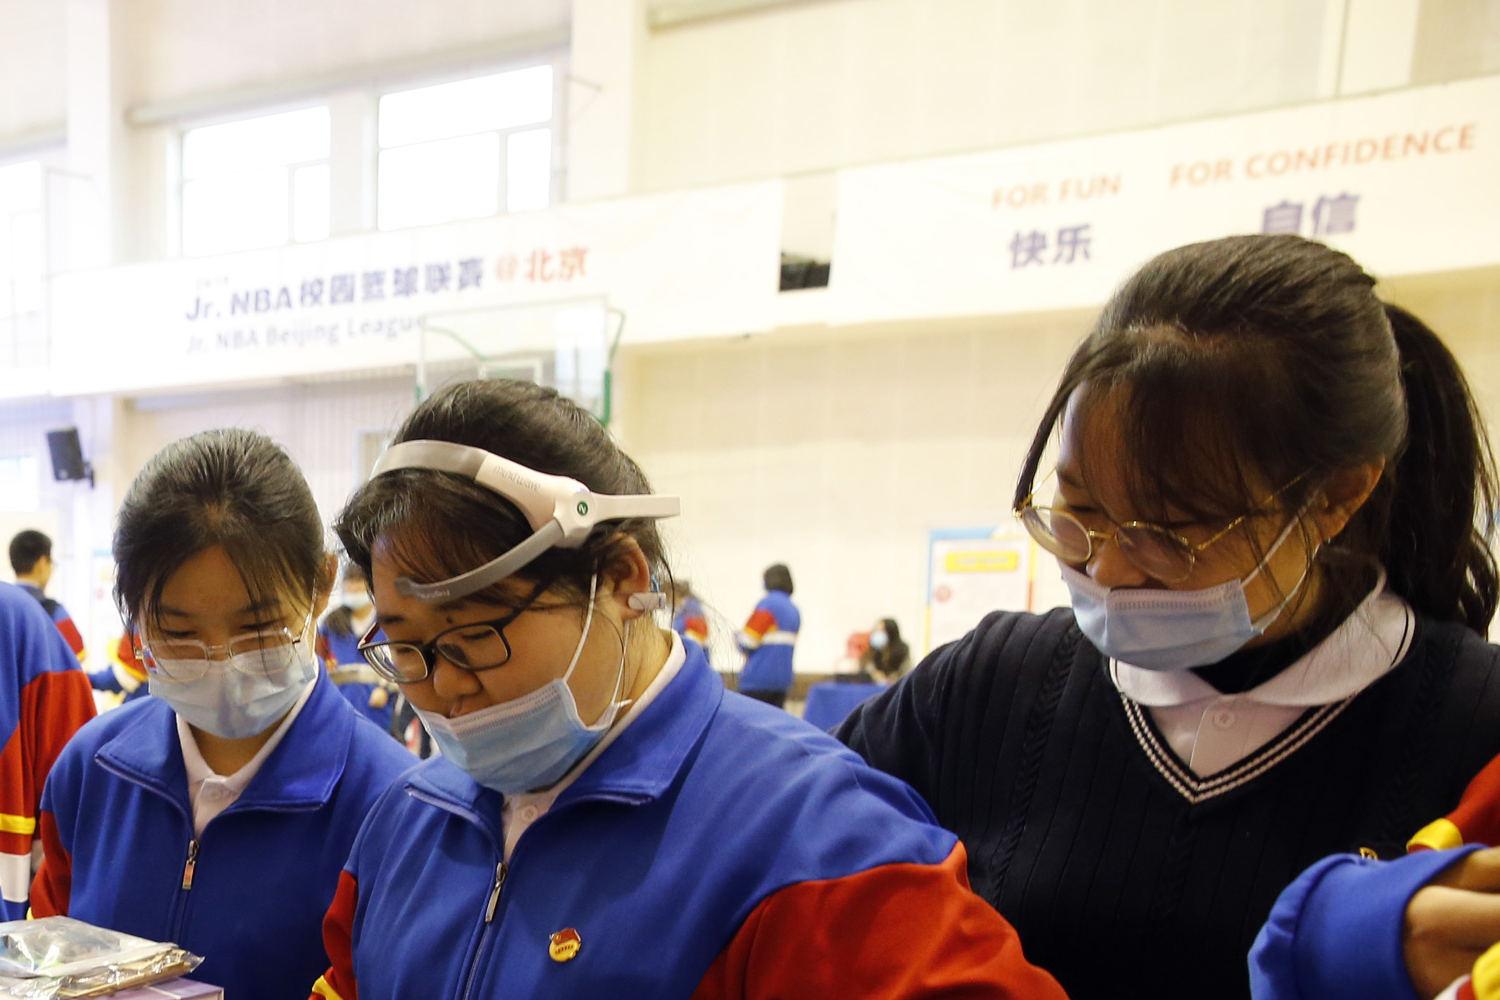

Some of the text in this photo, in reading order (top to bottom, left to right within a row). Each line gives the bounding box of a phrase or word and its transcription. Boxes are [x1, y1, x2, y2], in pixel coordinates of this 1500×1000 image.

[1170, 123, 1479, 190] FOR CONFIDENCE
[992, 174, 1122, 210] FOR FUN
[1262, 191, 1361, 236] 自信
[1010, 222, 1094, 270] 快乐
[185, 295, 222, 321] Jr.
[267, 318, 340, 346] Beijing
